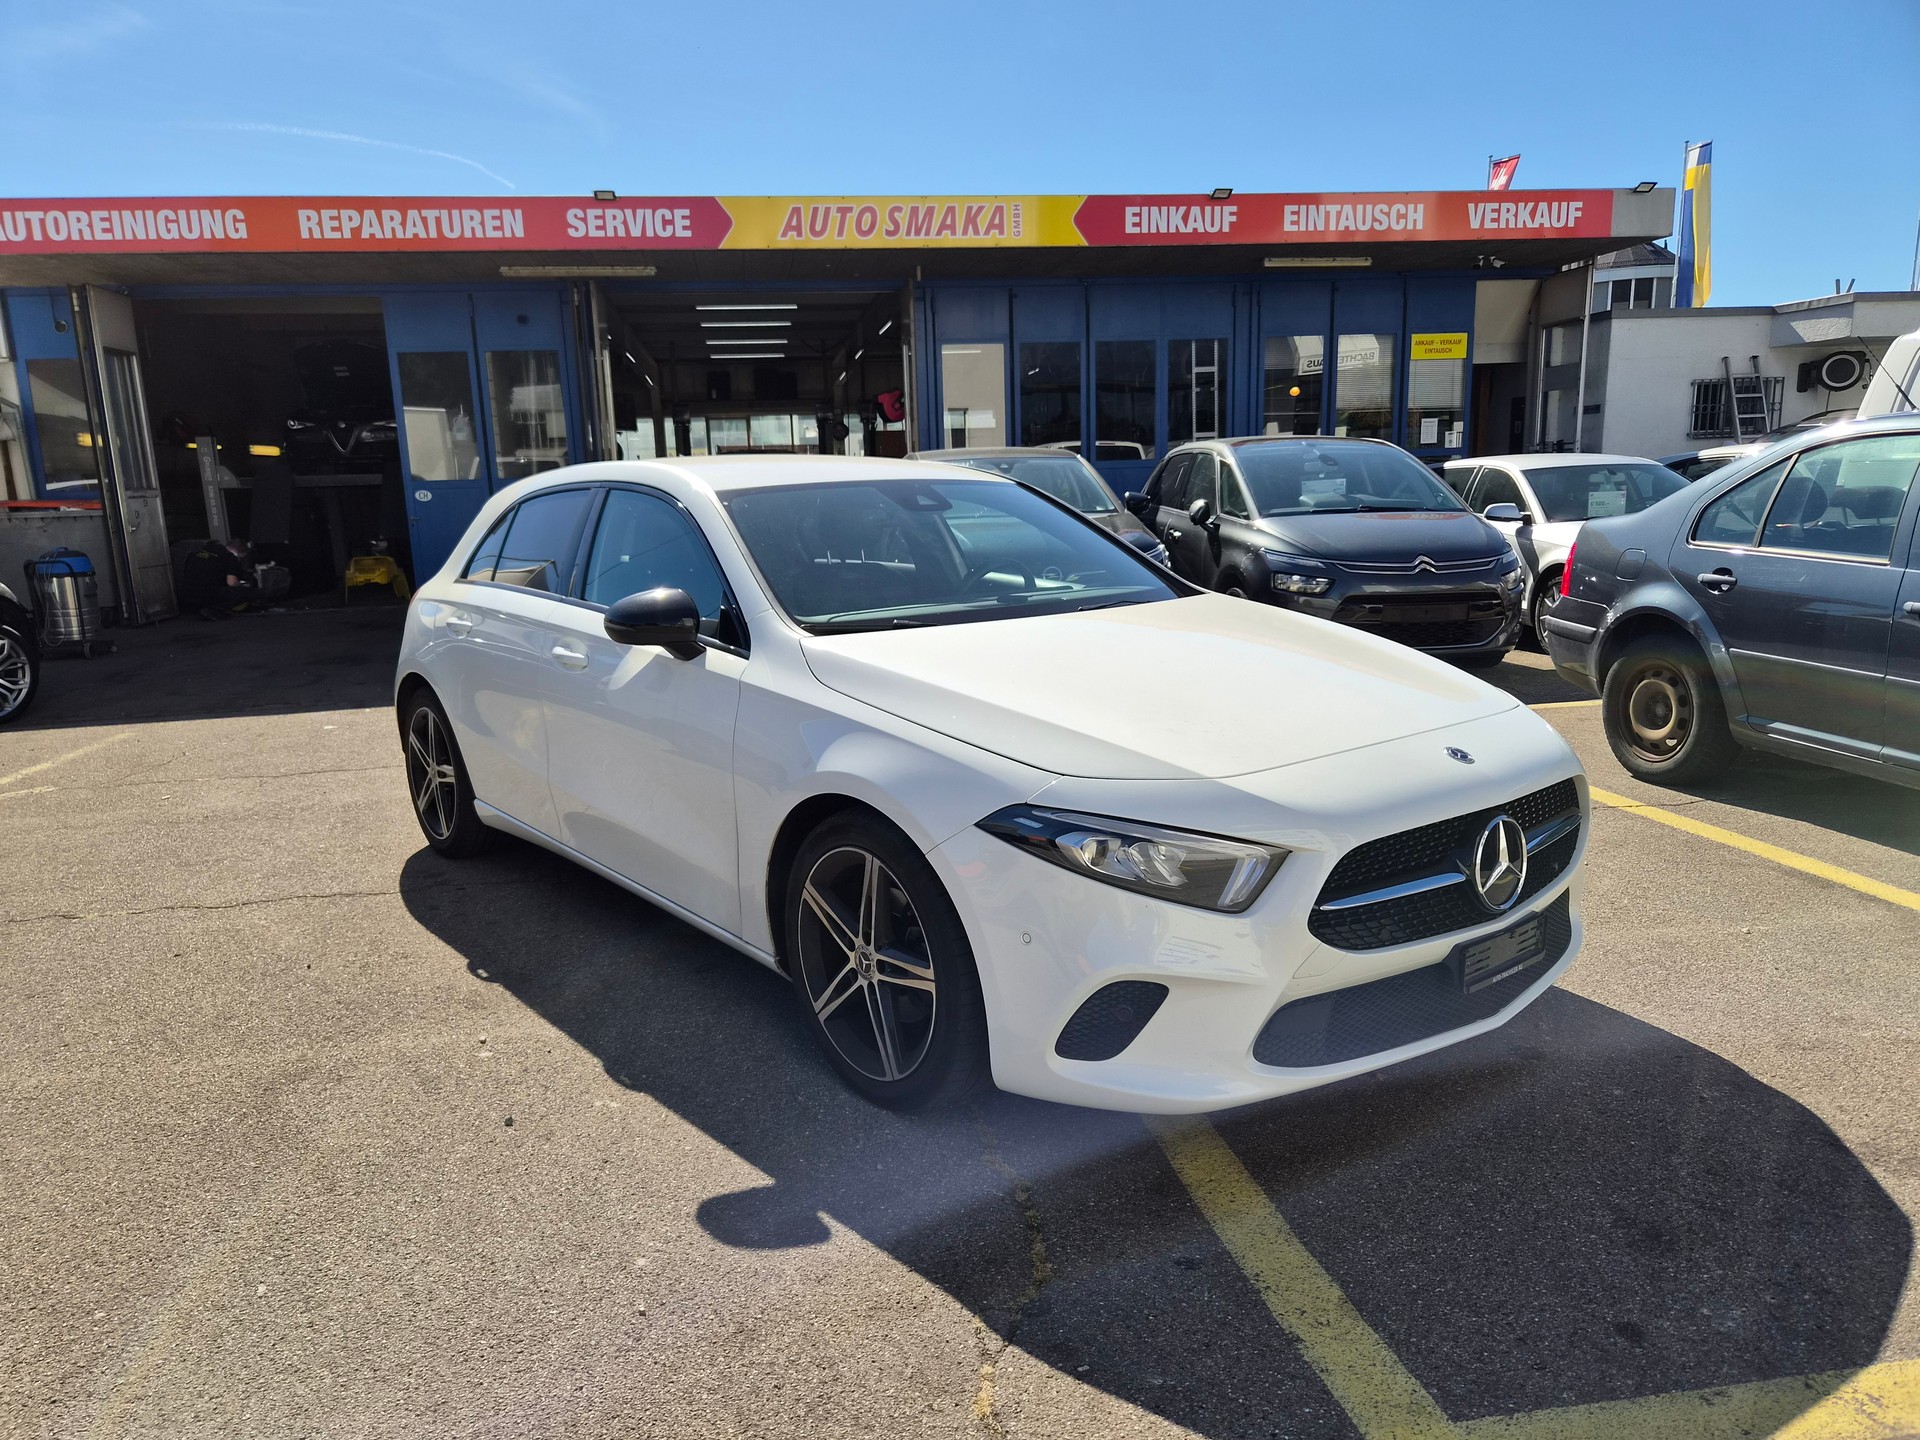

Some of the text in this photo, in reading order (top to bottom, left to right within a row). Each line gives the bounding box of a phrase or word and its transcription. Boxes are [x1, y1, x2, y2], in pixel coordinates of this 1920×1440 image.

[298, 208, 525, 239] REPARATUREN
[566, 208, 693, 238] SERVICE
[1012, 203, 1022, 238] GMBH
[1124, 201, 1583, 234] EINKAUF EINTAUSCH VERKAUF
[1439, 338, 1462, 346] VERKAUF
[418, 491, 429, 500] CH
